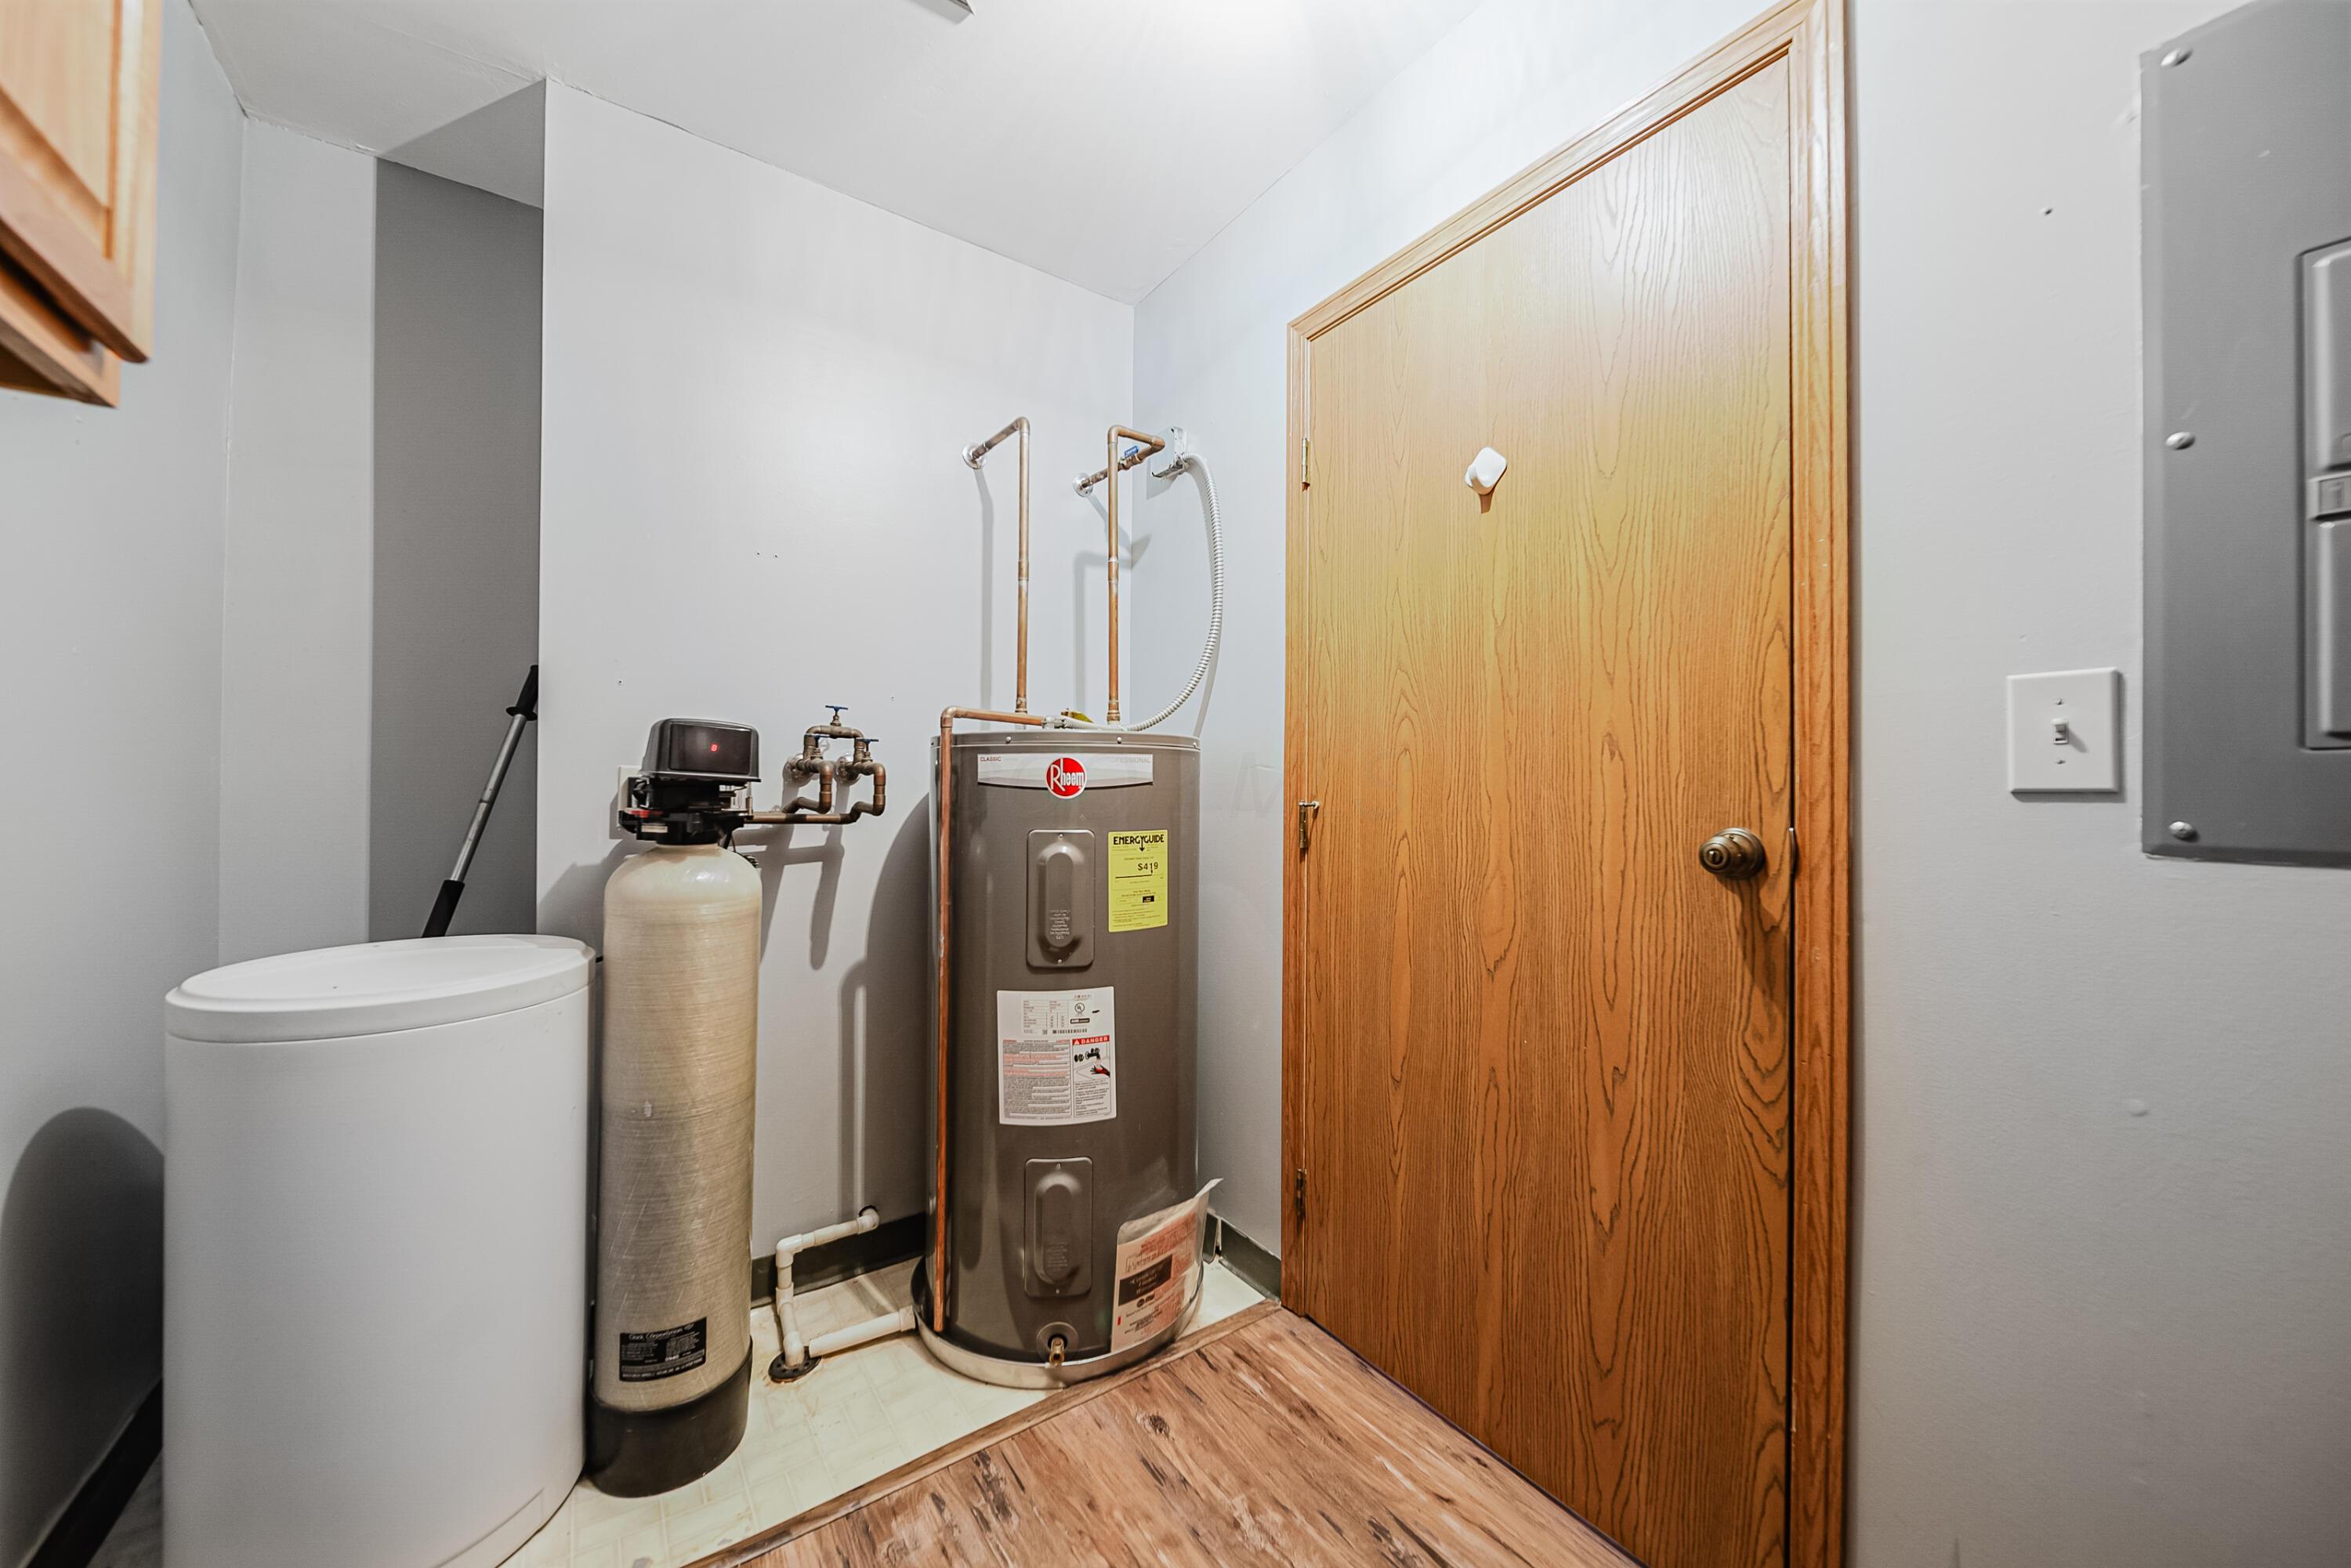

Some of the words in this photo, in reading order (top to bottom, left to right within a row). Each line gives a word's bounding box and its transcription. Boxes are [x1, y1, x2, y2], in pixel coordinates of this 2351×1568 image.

[1050, 757, 1085, 791] Rheem
[1113, 834, 1165, 846] ENERGYGUIDE
[1081, 1036, 1108, 1045] DANGER
